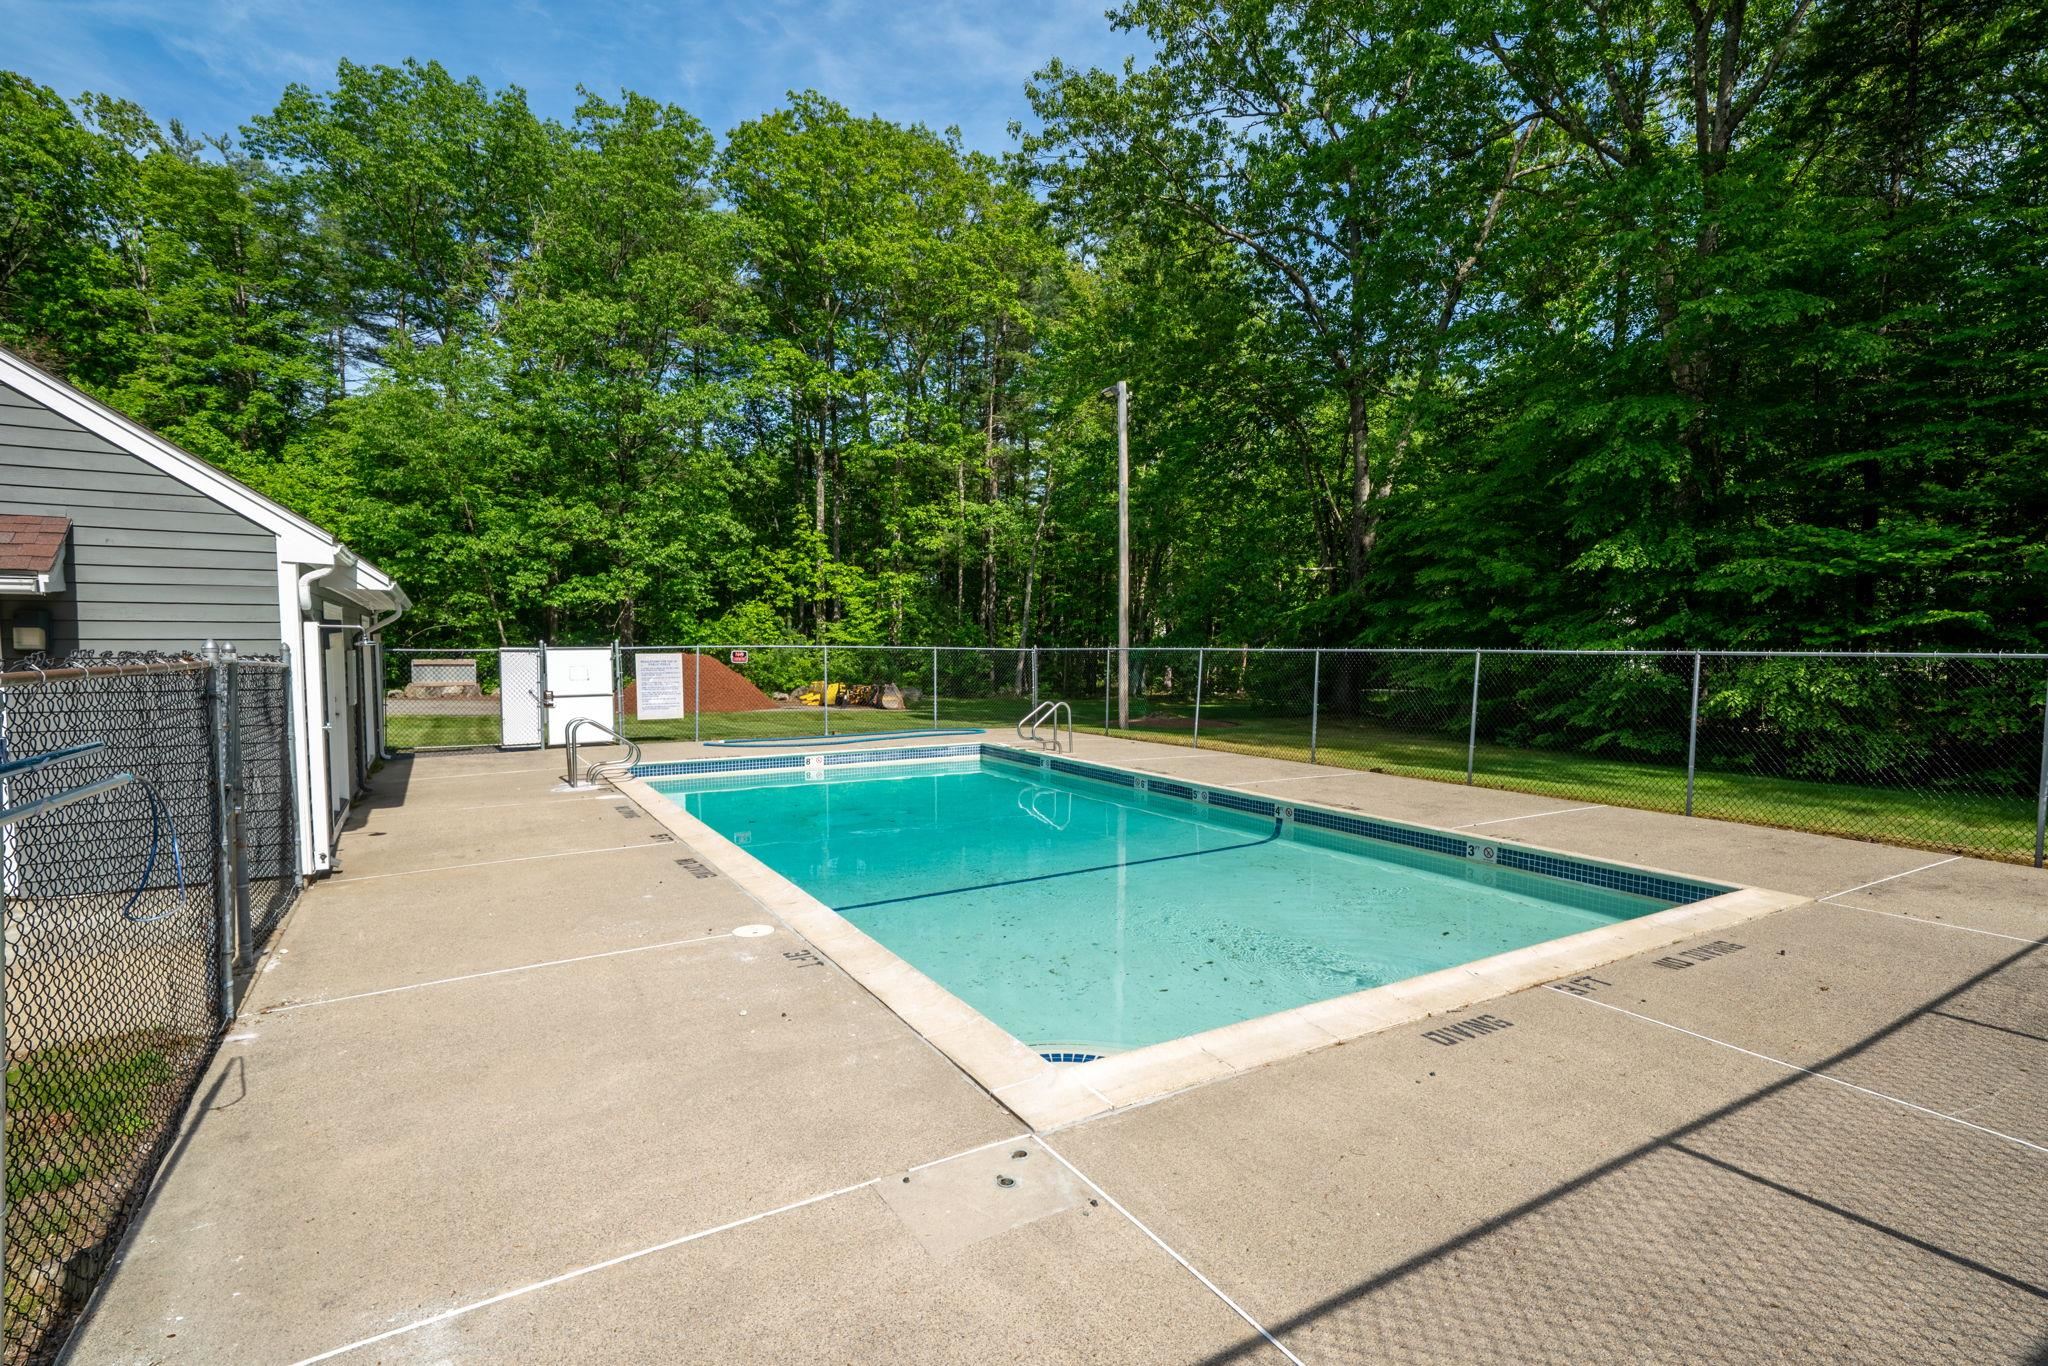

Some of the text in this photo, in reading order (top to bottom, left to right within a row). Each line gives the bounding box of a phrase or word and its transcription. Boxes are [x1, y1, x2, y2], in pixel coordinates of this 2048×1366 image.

[1651, 940, 1746, 971] NO DIVING
[1420, 1013, 1515, 1047] DIVING
